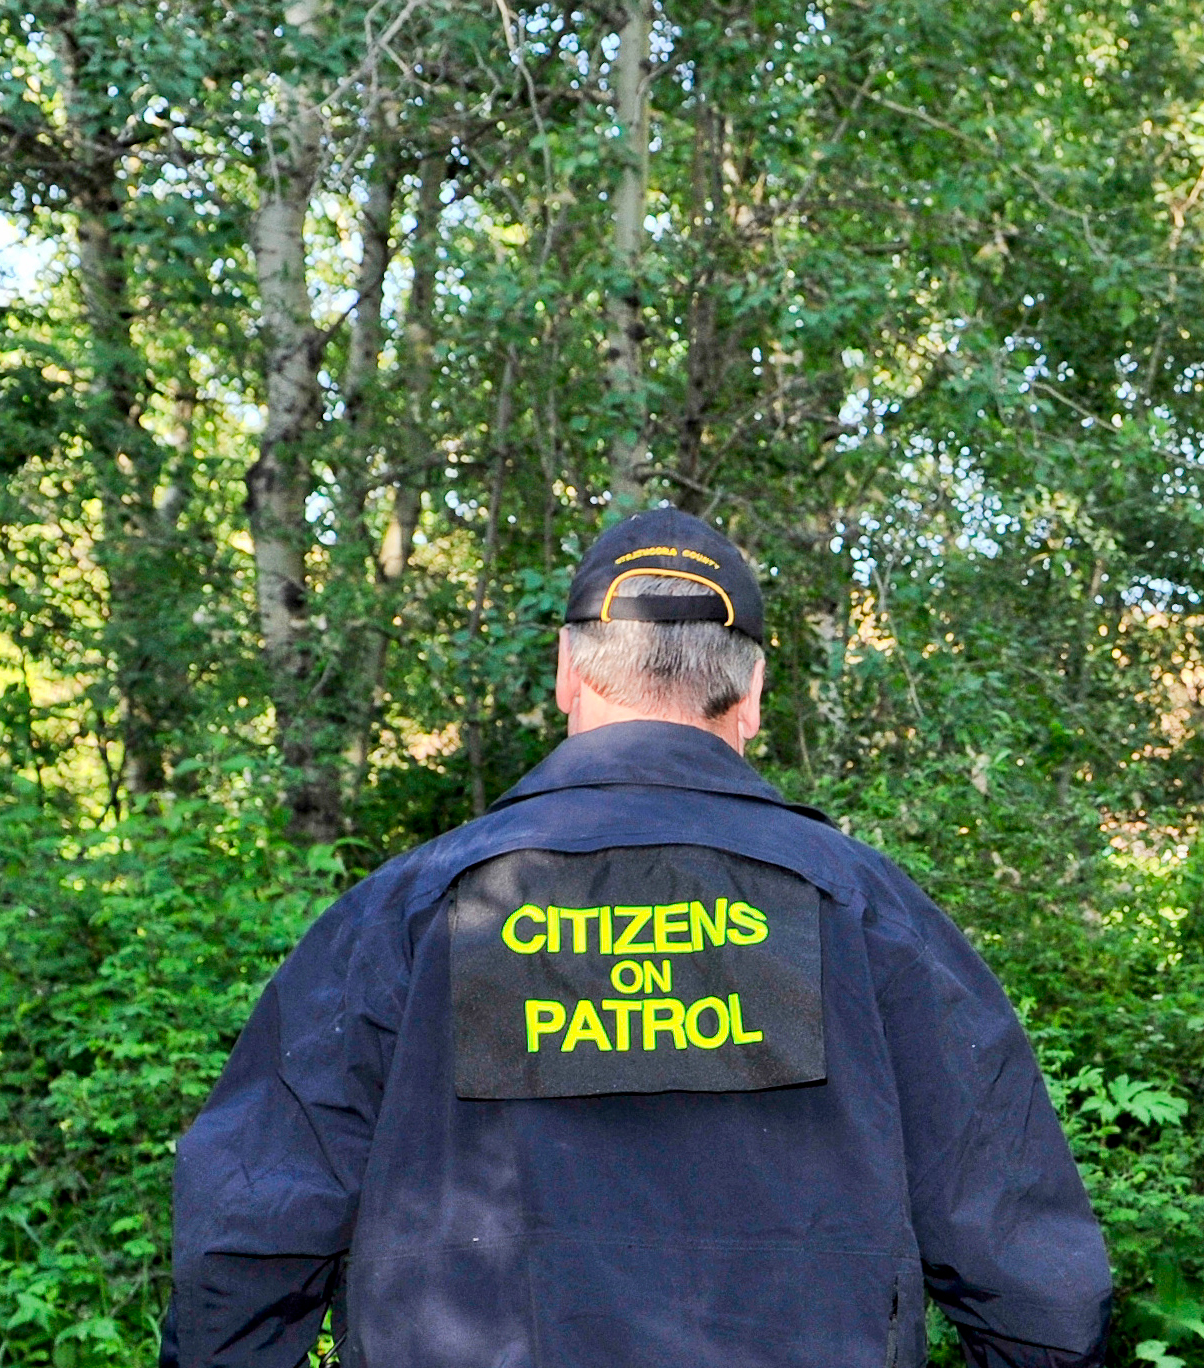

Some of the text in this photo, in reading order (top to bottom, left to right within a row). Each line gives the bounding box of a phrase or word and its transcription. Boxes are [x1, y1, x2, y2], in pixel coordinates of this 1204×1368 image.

[500, 897, 770, 956] CITIZENS
[610, 959, 673, 995] ON
[524, 993, 764, 1053] PATROL
